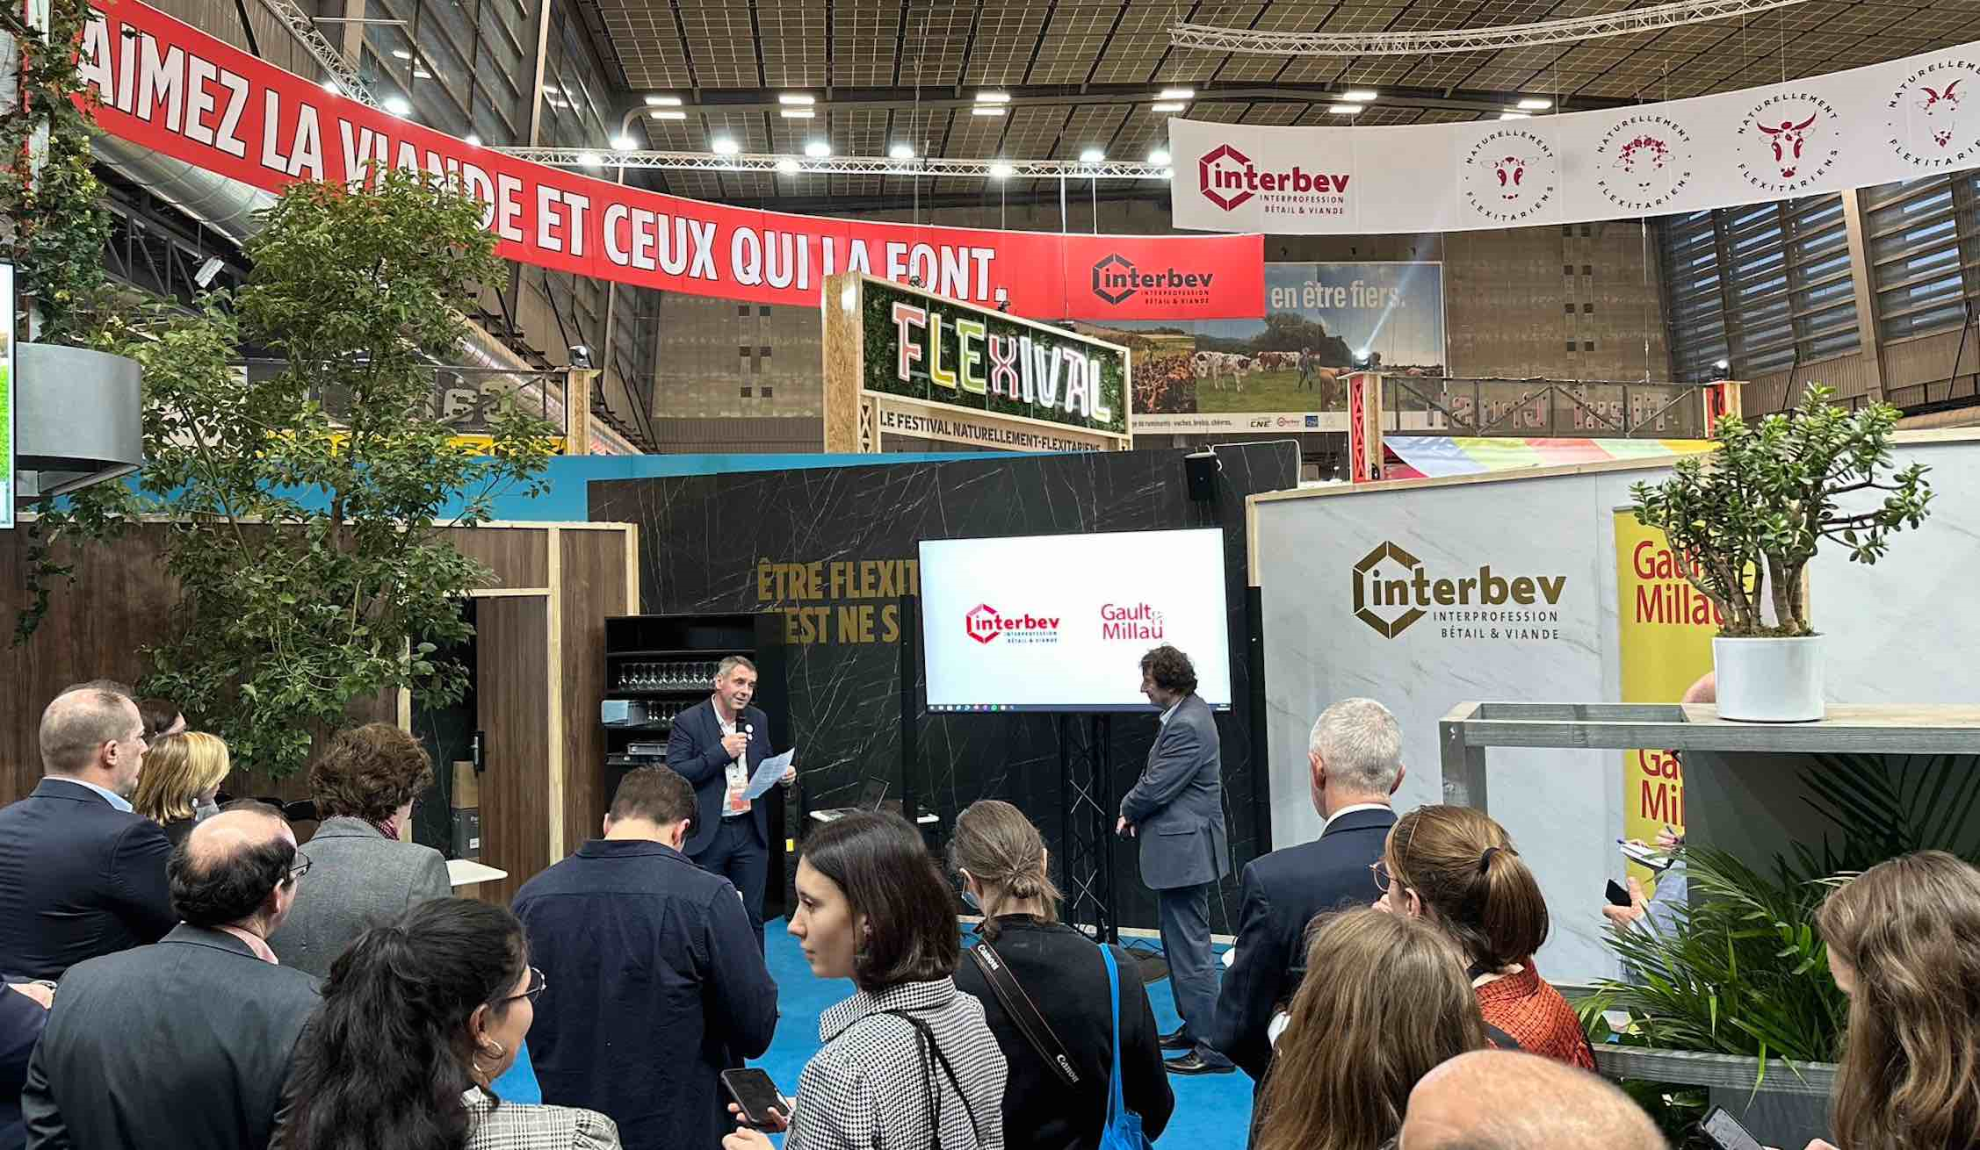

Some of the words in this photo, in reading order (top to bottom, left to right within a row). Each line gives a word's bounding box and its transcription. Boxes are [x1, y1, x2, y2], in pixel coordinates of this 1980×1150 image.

[1737, 93, 1838, 134] NATURELLEMENT
[1466, 130, 1554, 164] NATURELLEMENT
[1597, 115, 1690, 153] NATURELLEMENT
[75, 17, 249, 159] AIMEZ
[261, 87, 324, 185] LA
[536, 184, 590, 257] ET
[603, 202, 719, 282] CEUX
[731, 226, 810, 291] QUI
[886, 241, 1008, 302] FONT.
[1737, 150, 1838, 192] FLEXITARIENS
[1215, 163, 1350, 193] interbev
[1598, 171, 1691, 209] FLEXITARIENS
[1260, 194, 1344, 204] INTERPROFESSION
[1265, 205, 1295, 214] BÉTAIL
[1309, 207, 1344, 215] VIANDE
[1466, 186, 1554, 222] FLEXITARIENS
[1105, 267, 1214, 288] interbev
[1271, 286, 1297, 309] en
[1303, 280, 1346, 309] être
[892, 301, 1111, 424] FLEXIVAL
[880, 411, 895, 432] LE
[897, 413, 951, 436] FESTIVAL
[758, 557, 823, 600] ÊTRE
[830, 560, 918, 598] FLEXIT
[1372, 564, 1567, 606] interbev
[838, 605, 875, 644] NE
[976, 613, 1060, 630] interbev
[1433, 611, 1558, 622] INTERPROFESSION
[1441, 626, 1485, 638] BÉTAIL
[1490, 628, 1499, 639] &
[1505, 629, 1559, 639] VIANDE
[977, 944, 1000, 971] Canon
[1056, 1054, 1080, 1083] Canon
